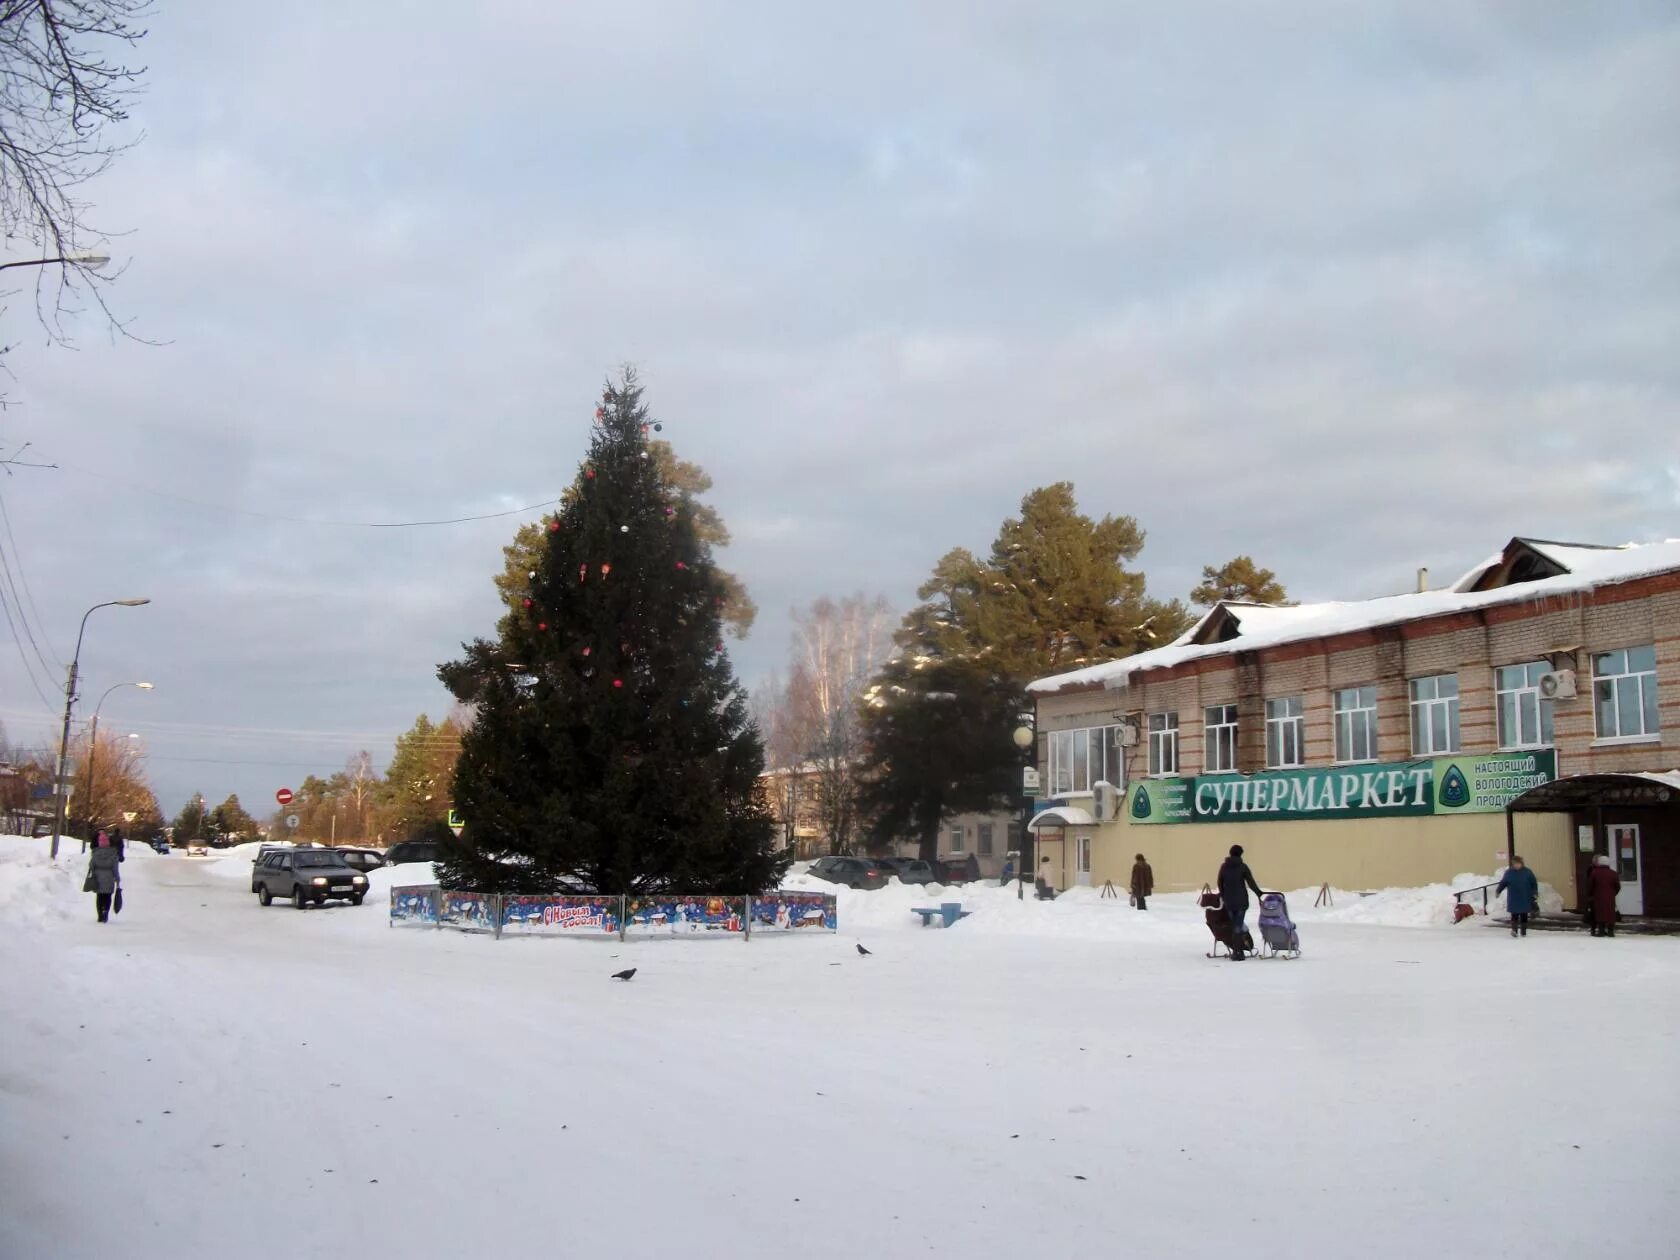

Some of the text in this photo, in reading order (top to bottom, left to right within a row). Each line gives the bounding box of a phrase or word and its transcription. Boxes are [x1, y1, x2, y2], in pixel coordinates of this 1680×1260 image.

[1475, 756, 1535, 774] НАСТОЯЩИЙ
[1475, 772, 1547, 790] ВОЛОГОДСКИЙ
[1194, 768, 1432, 814] СУПЕРМАРКЕТ
[544, 906, 552, 926] С
